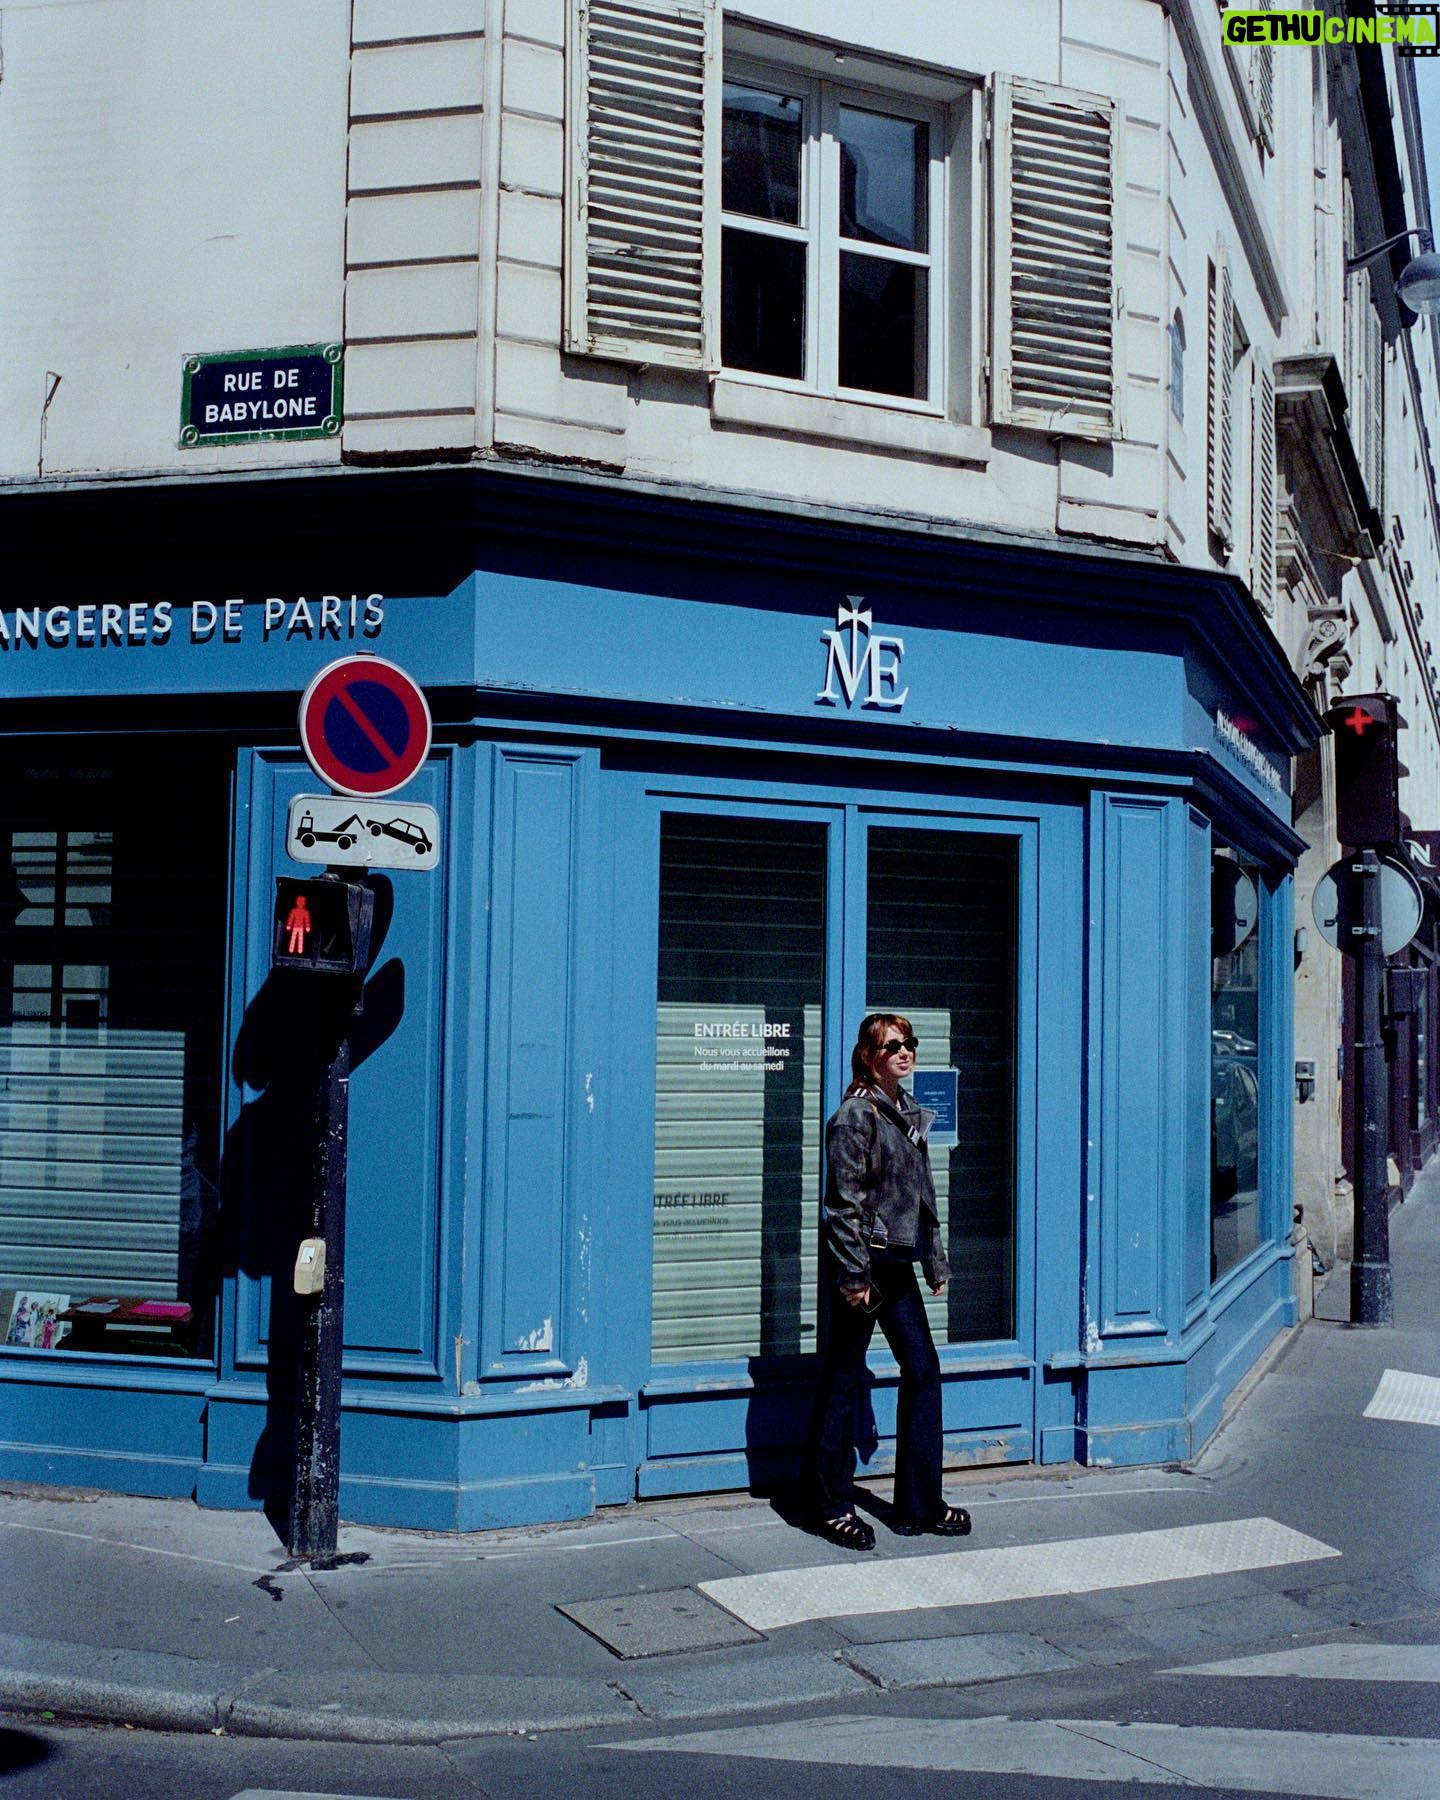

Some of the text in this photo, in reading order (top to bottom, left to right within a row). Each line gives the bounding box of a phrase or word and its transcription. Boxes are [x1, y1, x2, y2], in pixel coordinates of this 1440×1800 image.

[224, 369, 299, 392] RUE DE
[205, 397, 317, 423] BABYLONE
[192, 599, 244, 632] DE
[265, 593, 384, 630] PARIS
[694, 1021, 791, 1038] ENTRÉE LIBRE
[694, 1046, 790, 1057] Nous vous accueillons
